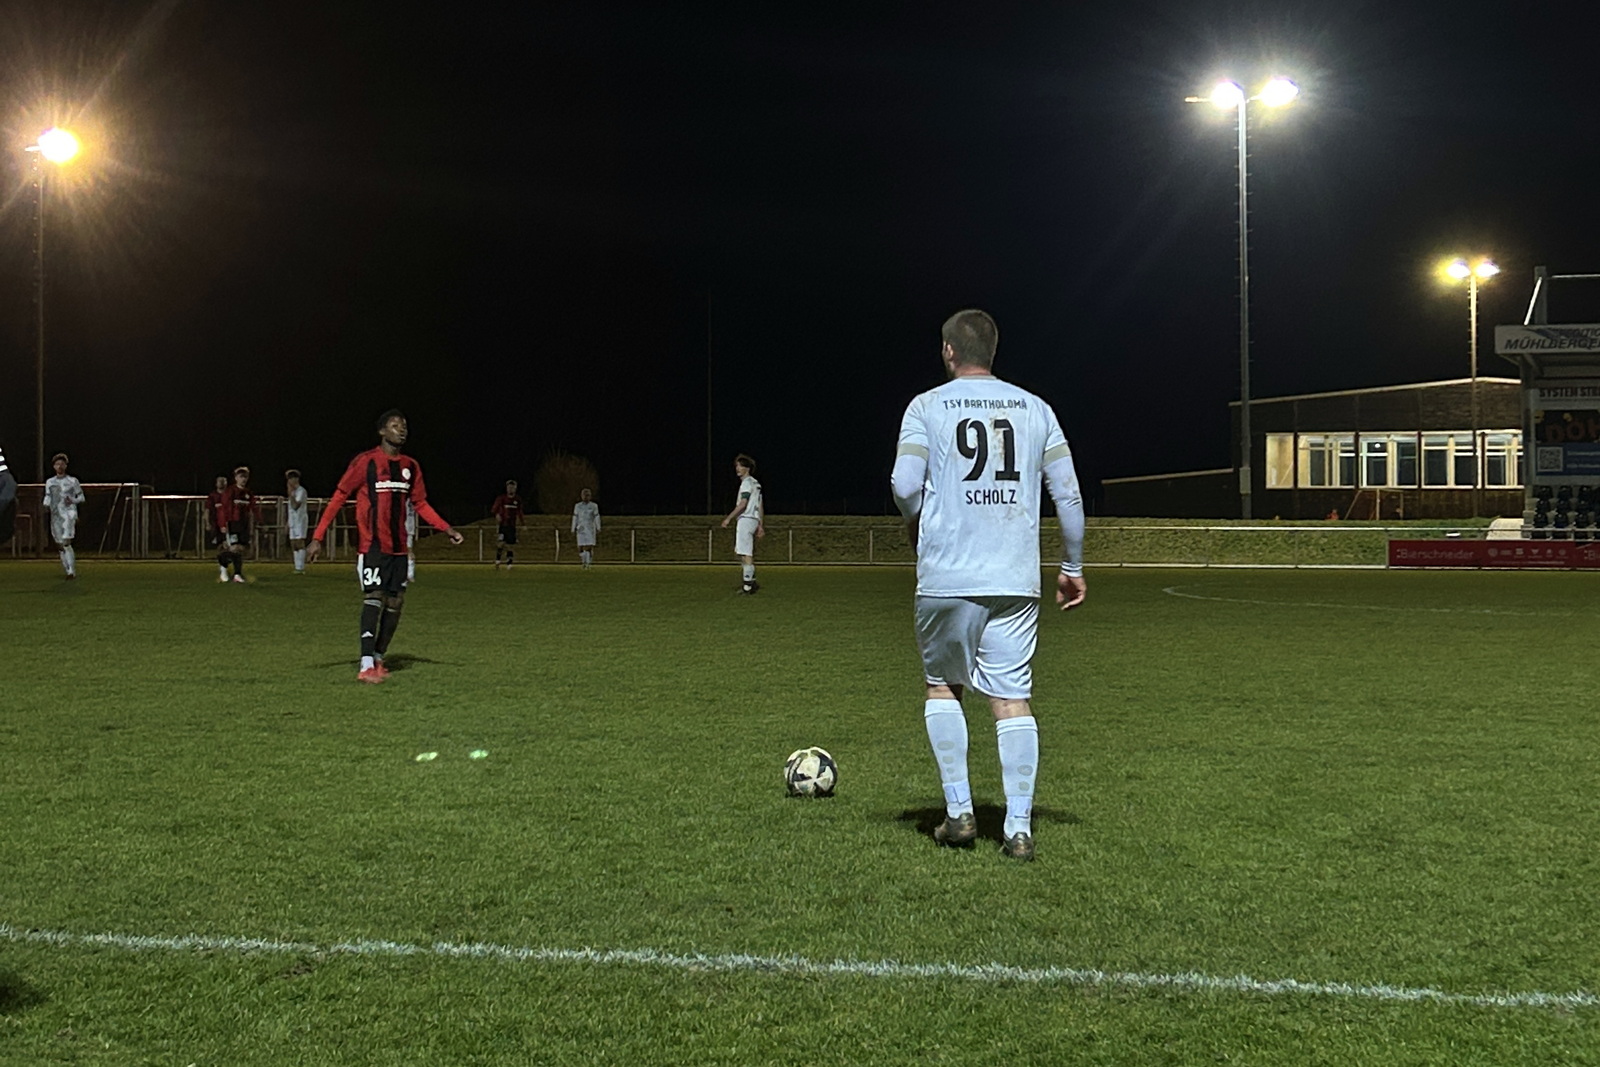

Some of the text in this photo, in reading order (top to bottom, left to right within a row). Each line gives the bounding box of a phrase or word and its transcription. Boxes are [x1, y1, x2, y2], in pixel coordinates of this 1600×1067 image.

[1504, 335, 1600, 350] MÜHLBERGE
[942, 398, 962, 410] TSV
[956, 417, 1021, 482] 91
[965, 489, 1017, 505] SCHOLZ
[363, 567, 382, 586] 34
